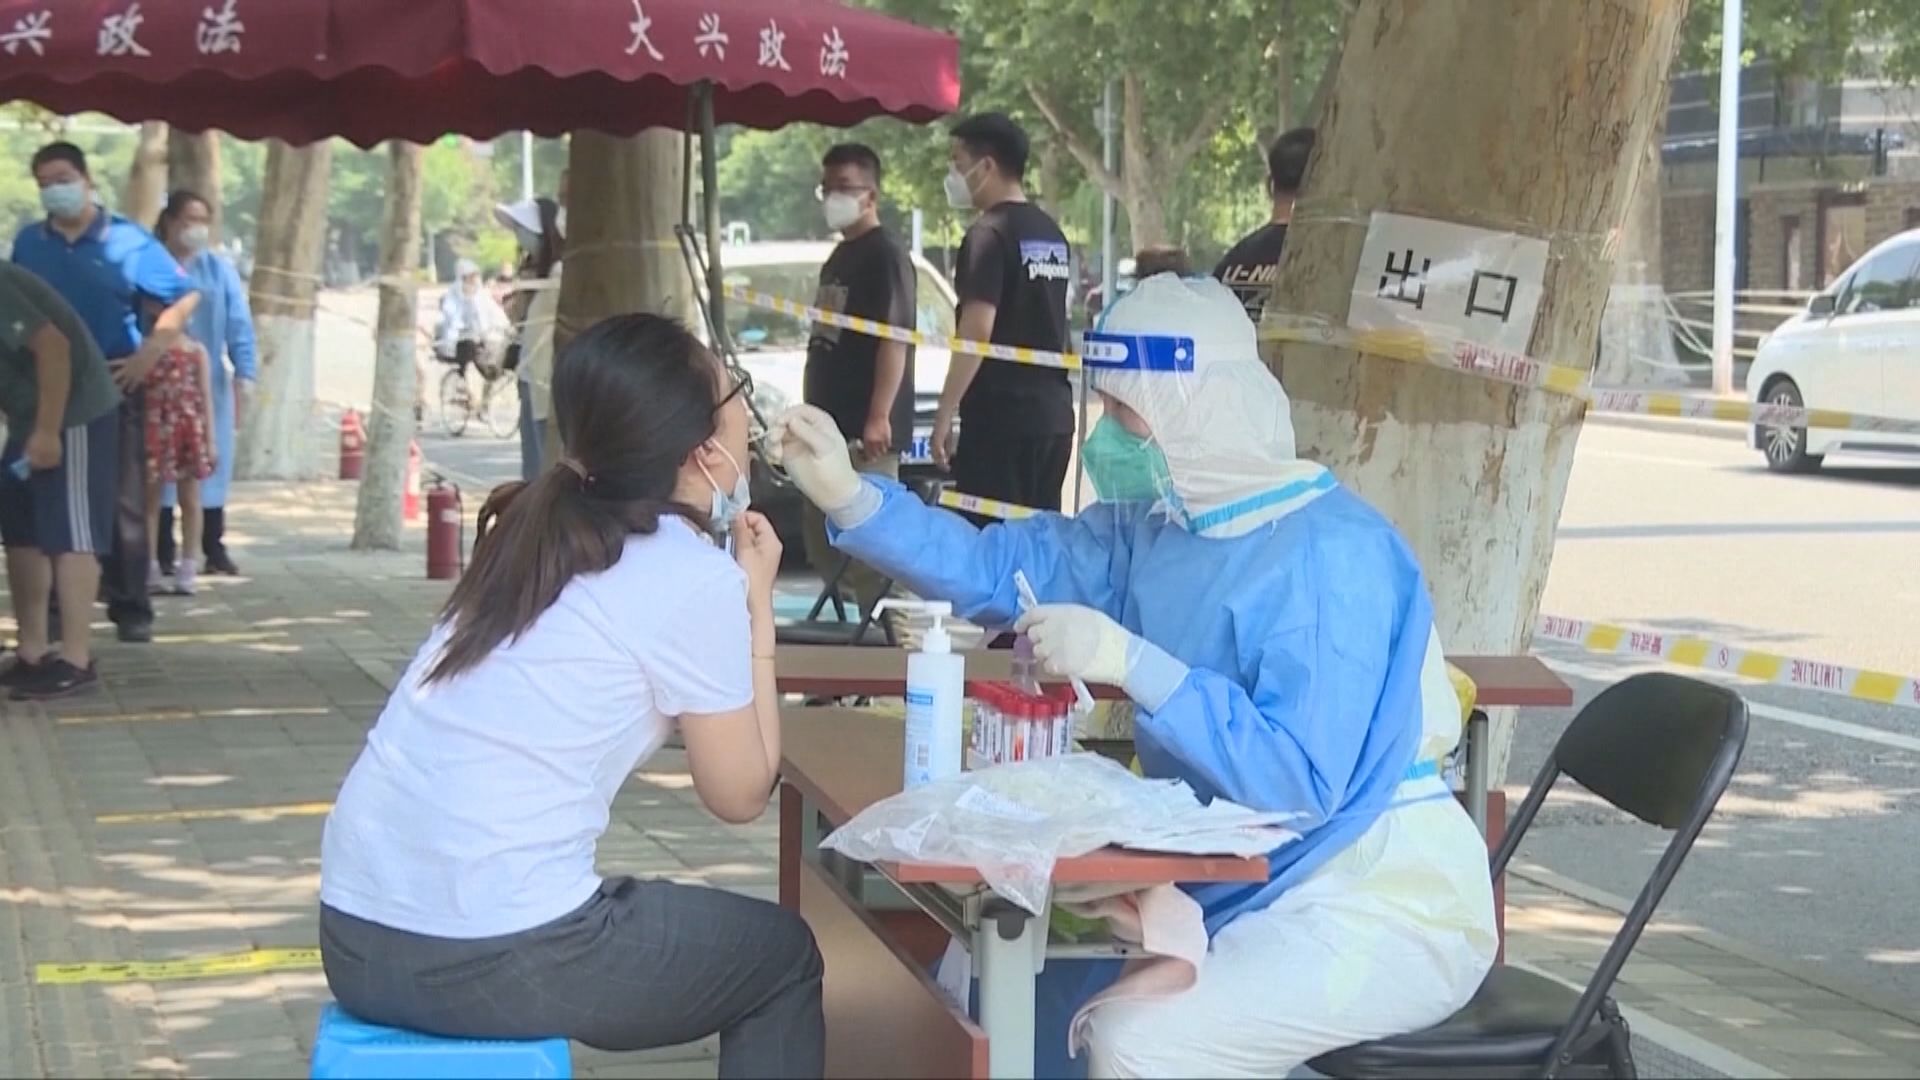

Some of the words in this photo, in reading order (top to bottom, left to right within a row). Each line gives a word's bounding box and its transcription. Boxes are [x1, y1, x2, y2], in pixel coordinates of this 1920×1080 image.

[0, 0, 246, 57] 兴政法
[625, 0, 850, 79] 大兴政法
[1222, 263, 1279, 283] LI-NI
[1377, 248, 1518, 323] 出口
[1790, 658, 1843, 690] LIMITLINE
